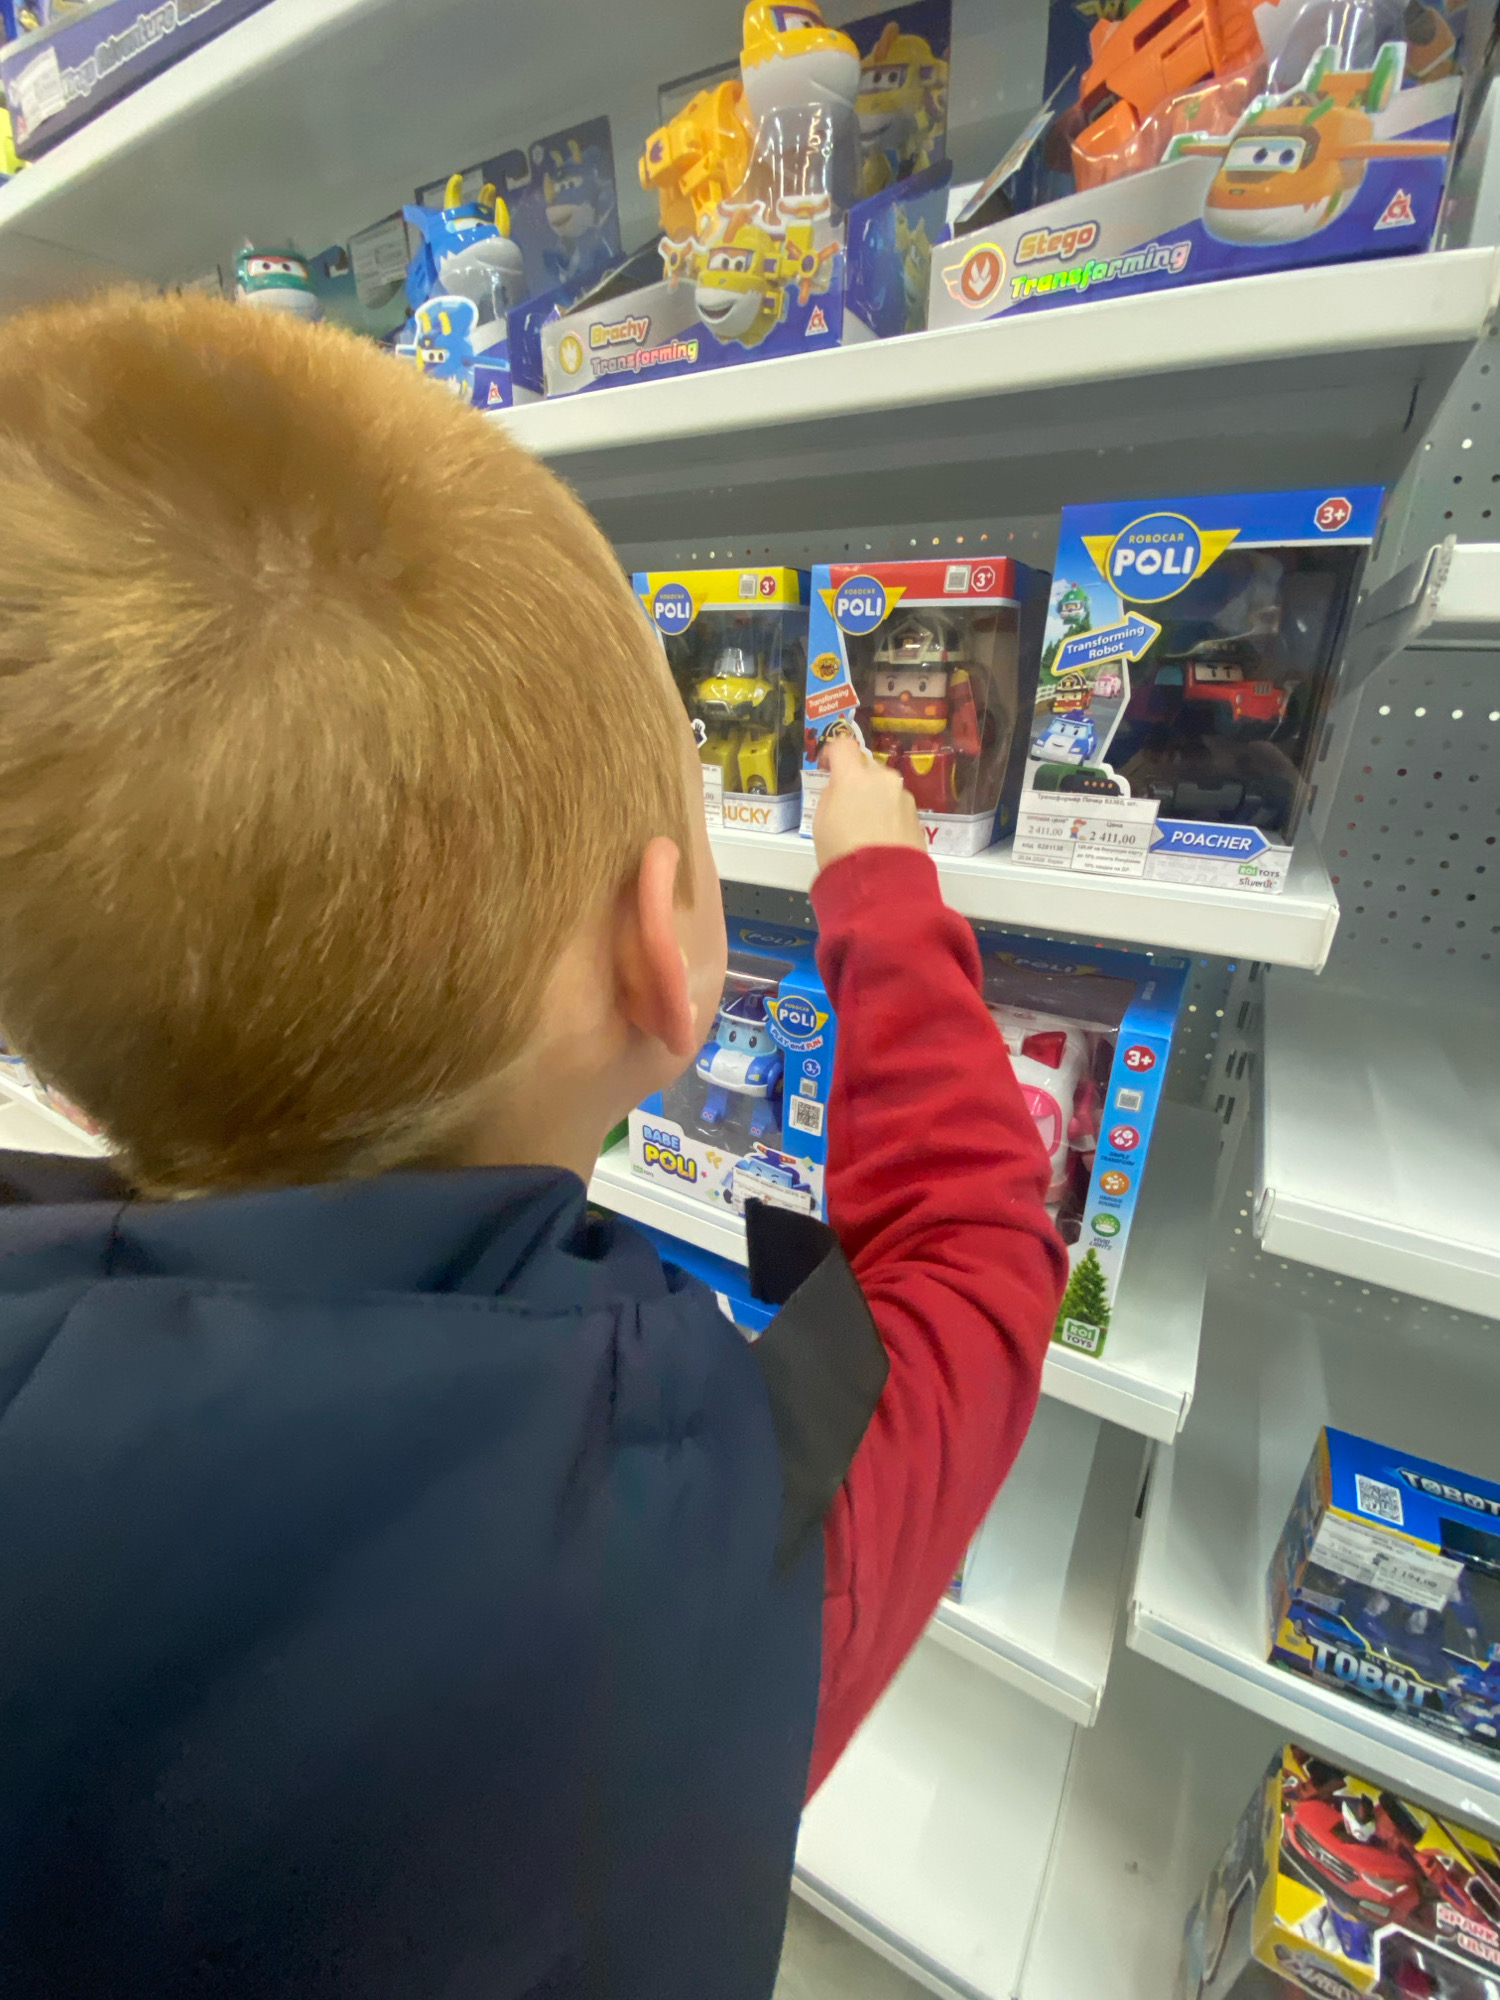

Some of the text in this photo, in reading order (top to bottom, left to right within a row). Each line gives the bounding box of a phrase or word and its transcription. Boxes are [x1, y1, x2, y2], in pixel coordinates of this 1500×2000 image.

[1015, 223, 1098, 264] Stego
[1011, 241, 1191, 302] Transforming
[590, 315, 651, 348] Brachy
[590, 339, 699, 375] Transforming
[1321, 507, 1346, 524] 3+
[1129, 533, 1184, 544] ROBOCAR
[1113, 546, 1195, 576] POLI
[762, 580, 774, 594] 3+
[976, 572, 992, 588] 3+
[655, 602, 690, 619] POLI
[837, 598, 882, 617] POLI
[1067, 624, 1145, 655] Transforming
[1088, 641, 1124, 660] Robot
[809, 689, 849, 709] Transforming
[818, 701, 839, 713] Robot
[1099, 832, 1136, 844] 411,00
[1171, 831, 1252, 850] POACHER
[1259, 869, 1280, 878] TOYS
[779, 1008, 815, 1028] POLI
[806, 1038, 822, 1050] FUN
[1126, 1050, 1153, 1067] 3+
[643, 1125, 680, 1151] BABE
[644, 1142, 697, 1183] POLI
[1067, 1334, 1092, 1348] TOYS
[1070, 1325, 1092, 1340] ROI
[1401, 1470, 1500, 1516] TOBOT
[1308, 1635, 1433, 1707] TOBOT
